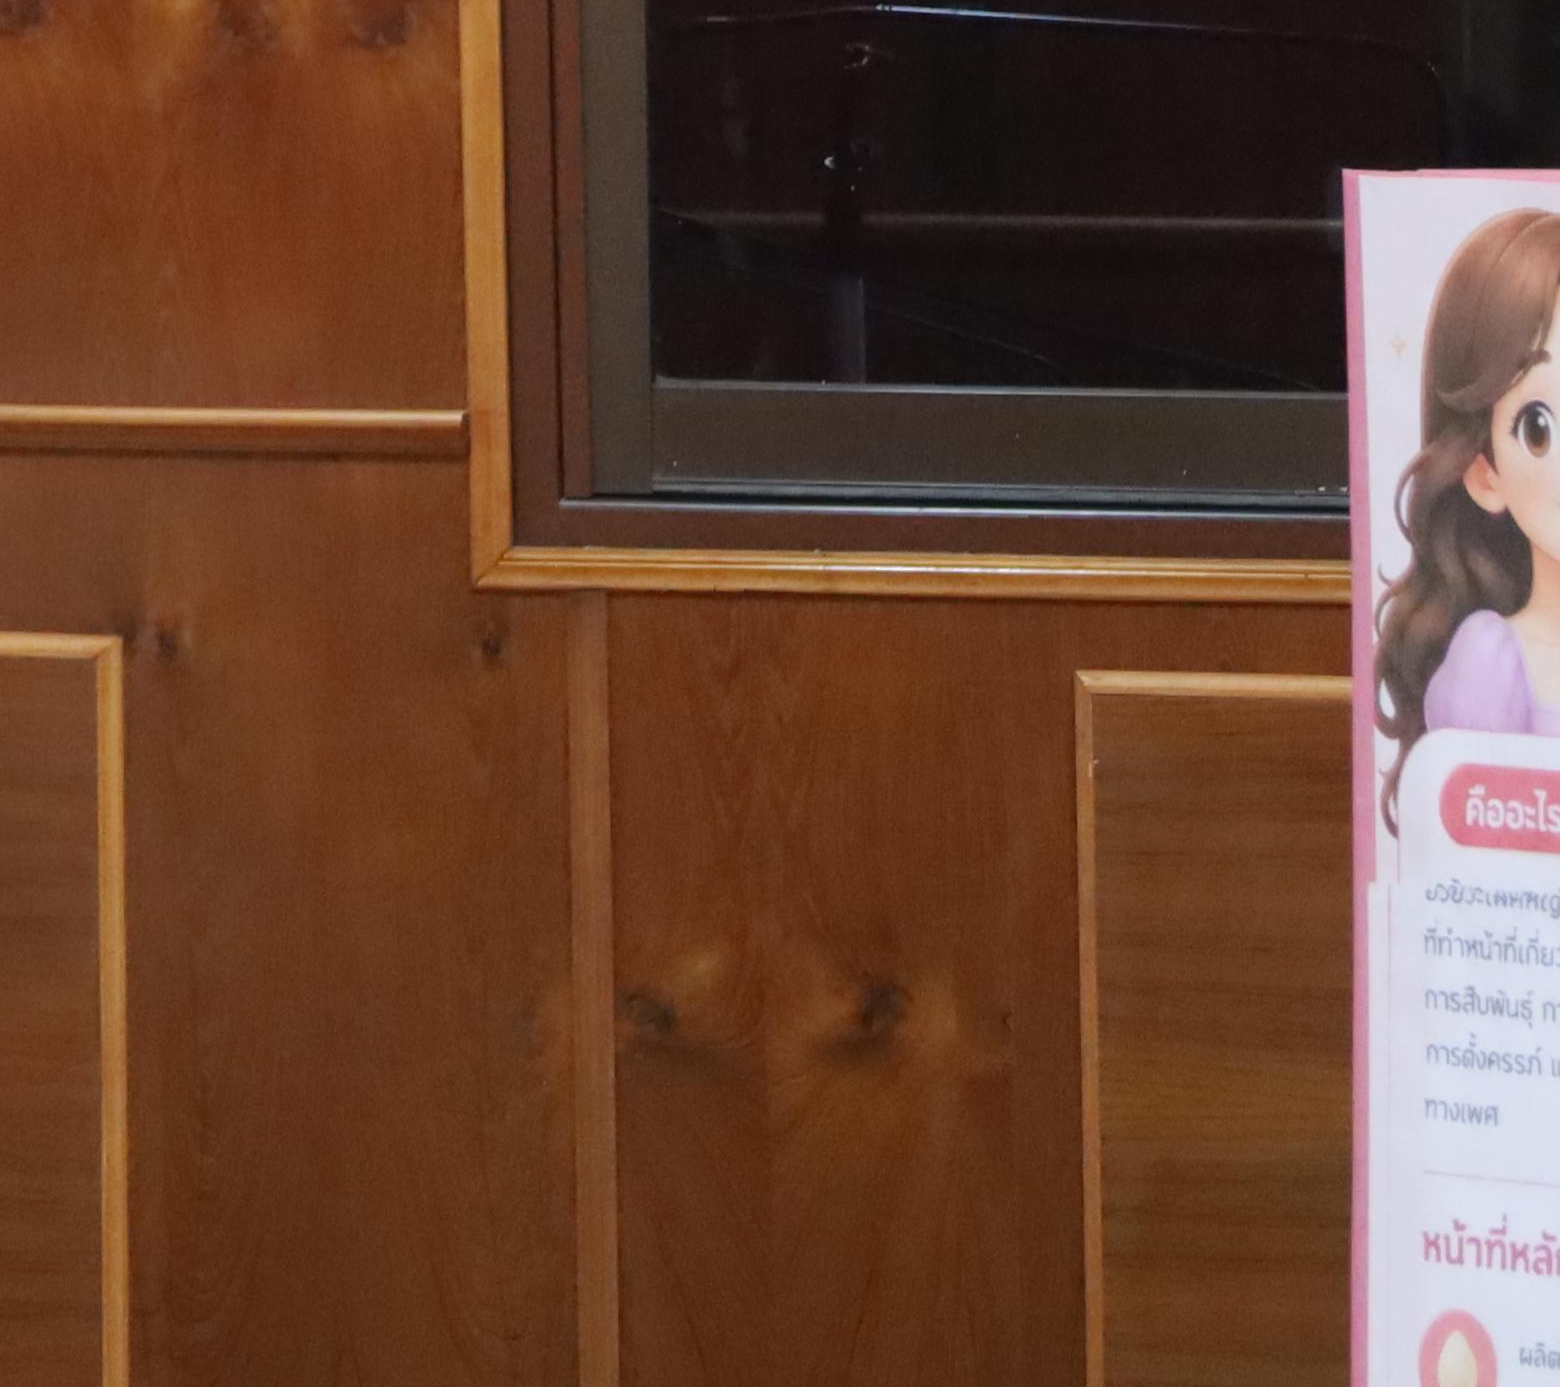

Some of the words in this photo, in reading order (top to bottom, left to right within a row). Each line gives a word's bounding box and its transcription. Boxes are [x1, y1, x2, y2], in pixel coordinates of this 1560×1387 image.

[1424, 985, 1535, 1029] การสืบพันธุ์
[1426, 1030, 1543, 1077] การตั้งครรภ์
[1424, 1096, 1500, 1127] ทางเพศ
[1421, 1213, 1560, 1278] หน้าที่หลั
